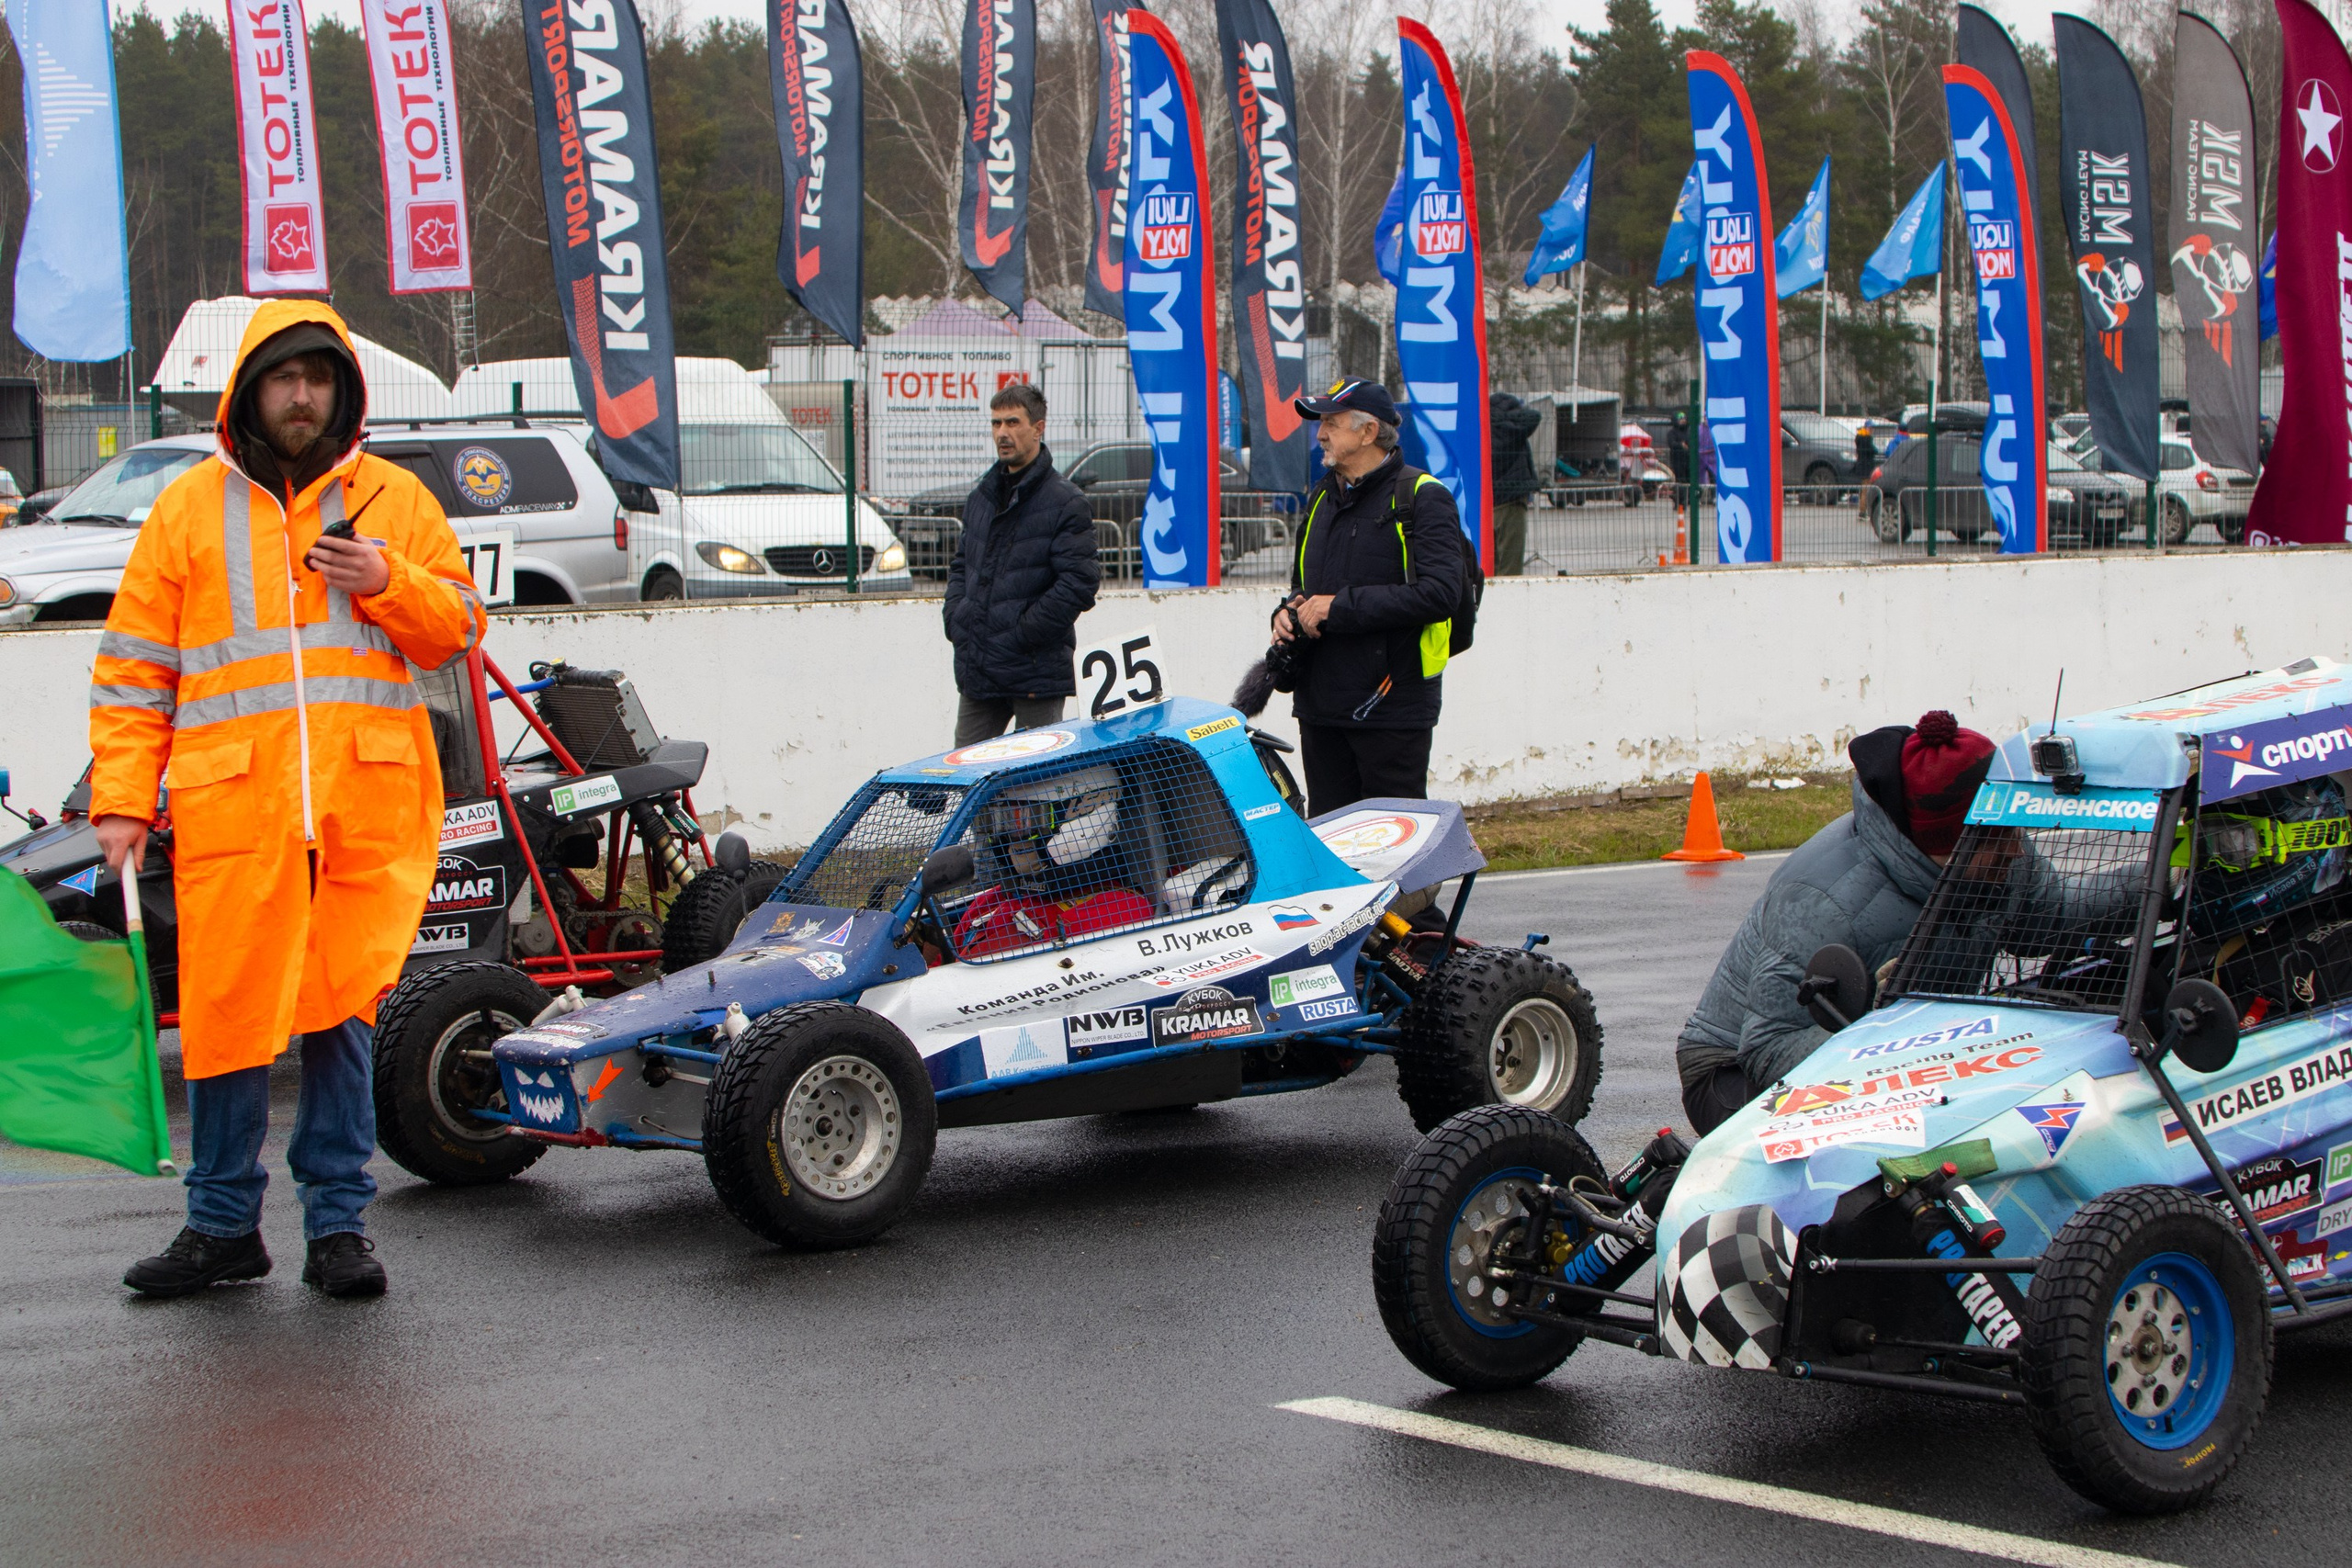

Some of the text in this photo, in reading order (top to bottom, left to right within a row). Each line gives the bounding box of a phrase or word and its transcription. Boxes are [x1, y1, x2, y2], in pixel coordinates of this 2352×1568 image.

[281, 4, 305, 184] ТОПЛИВНЫЕ ТЕХНОЛОГИИ
[426, 6, 452, 182] ТОПЛИВНЫЕ ТЕХНОЛОГИИ
[882, 351, 1012, 361] СПОРТИВНОЕ ТОПЛИВО
[1081, 635, 1163, 716] 25
[1190, 716, 1237, 739] Sabelt
[557, 784, 617, 808] IP integra
[2008, 791, 2159, 819] Раменское
[445, 804, 495, 826] KA ADV
[440, 829, 454, 840] RO
[457, 822, 493, 837] RACING
[425, 897, 494, 912] OTORSPORT
[414, 924, 468, 943] WB
[1137, 921, 1253, 957] В.Лужков
[1172, 947, 1252, 976] YUKA ADV
[1195, 967, 1217, 978] PRO
[956, 969, 1105, 1016] Команда Им.
[1295, 974, 1337, 992] integra
[1187, 989, 1224, 1005] КУБОК
[1302, 998, 1359, 1020] RUSTA
[1069, 1009, 1145, 1033] NWB
[1162, 1008, 1251, 1036] KRAMAR
[1191, 1024, 1252, 1041] MOTORSPORT
[1850, 1017, 1996, 1061] RUSTA
[1866, 1032, 2035, 1077] Racing Team
[1772, 1046, 2044, 1118] АЛЕКС
[1883, 1089, 1935, 1103] ADV
[2197, 1075, 2285, 1128] ИСАЕВ
[1619, 1156, 1645, 1183] CFMOTO
[2236, 1159, 2284, 1184] КУБОК
[1946, 1199, 1974, 1233] CFMOTO
